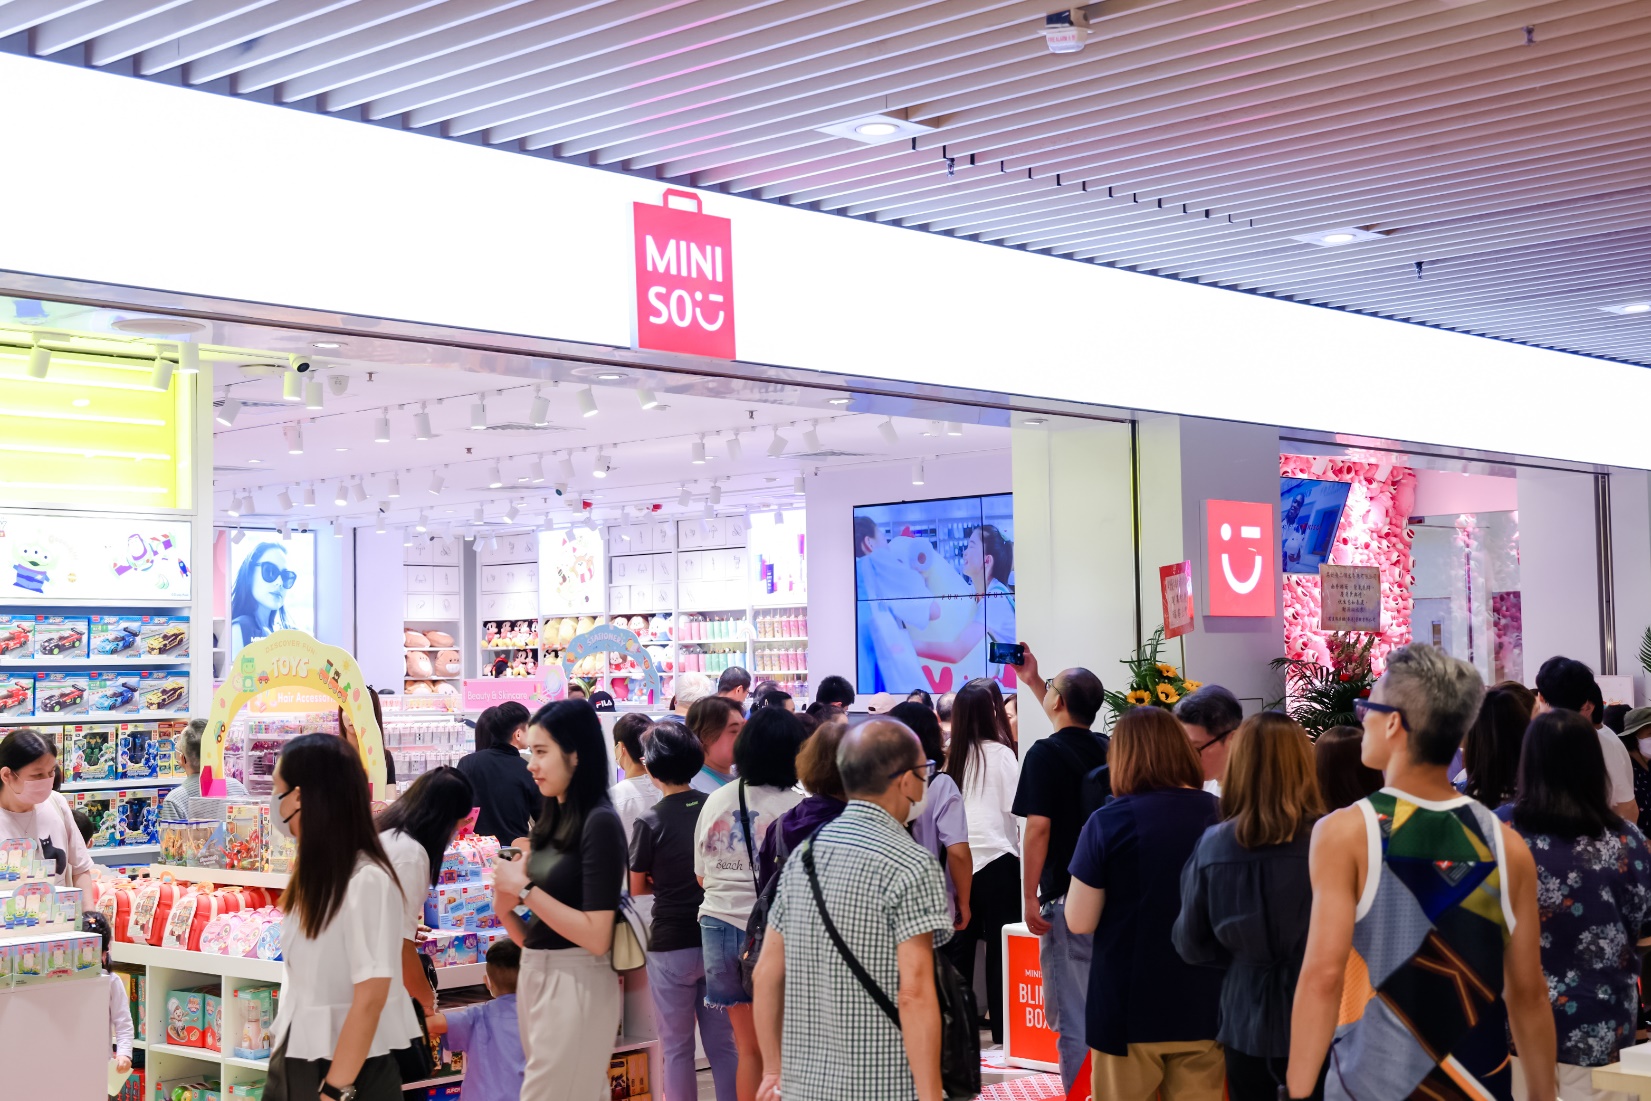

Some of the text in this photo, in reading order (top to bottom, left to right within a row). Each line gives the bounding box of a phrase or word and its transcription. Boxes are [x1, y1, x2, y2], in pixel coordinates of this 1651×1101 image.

[646, 234, 723, 282] MINI
[586, 631, 626, 647] STATIONERY
[266, 640, 315, 654] DISCOVER FUN
[272, 656, 310, 678] TOYS
[277, 692, 333, 704] Hair Accessor
[467, 691, 528, 701] Beauty & Skincare
[596, 700, 612, 708] FILA
[715, 860, 743, 871] Beach
[1025, 969, 1042, 978] MINI
